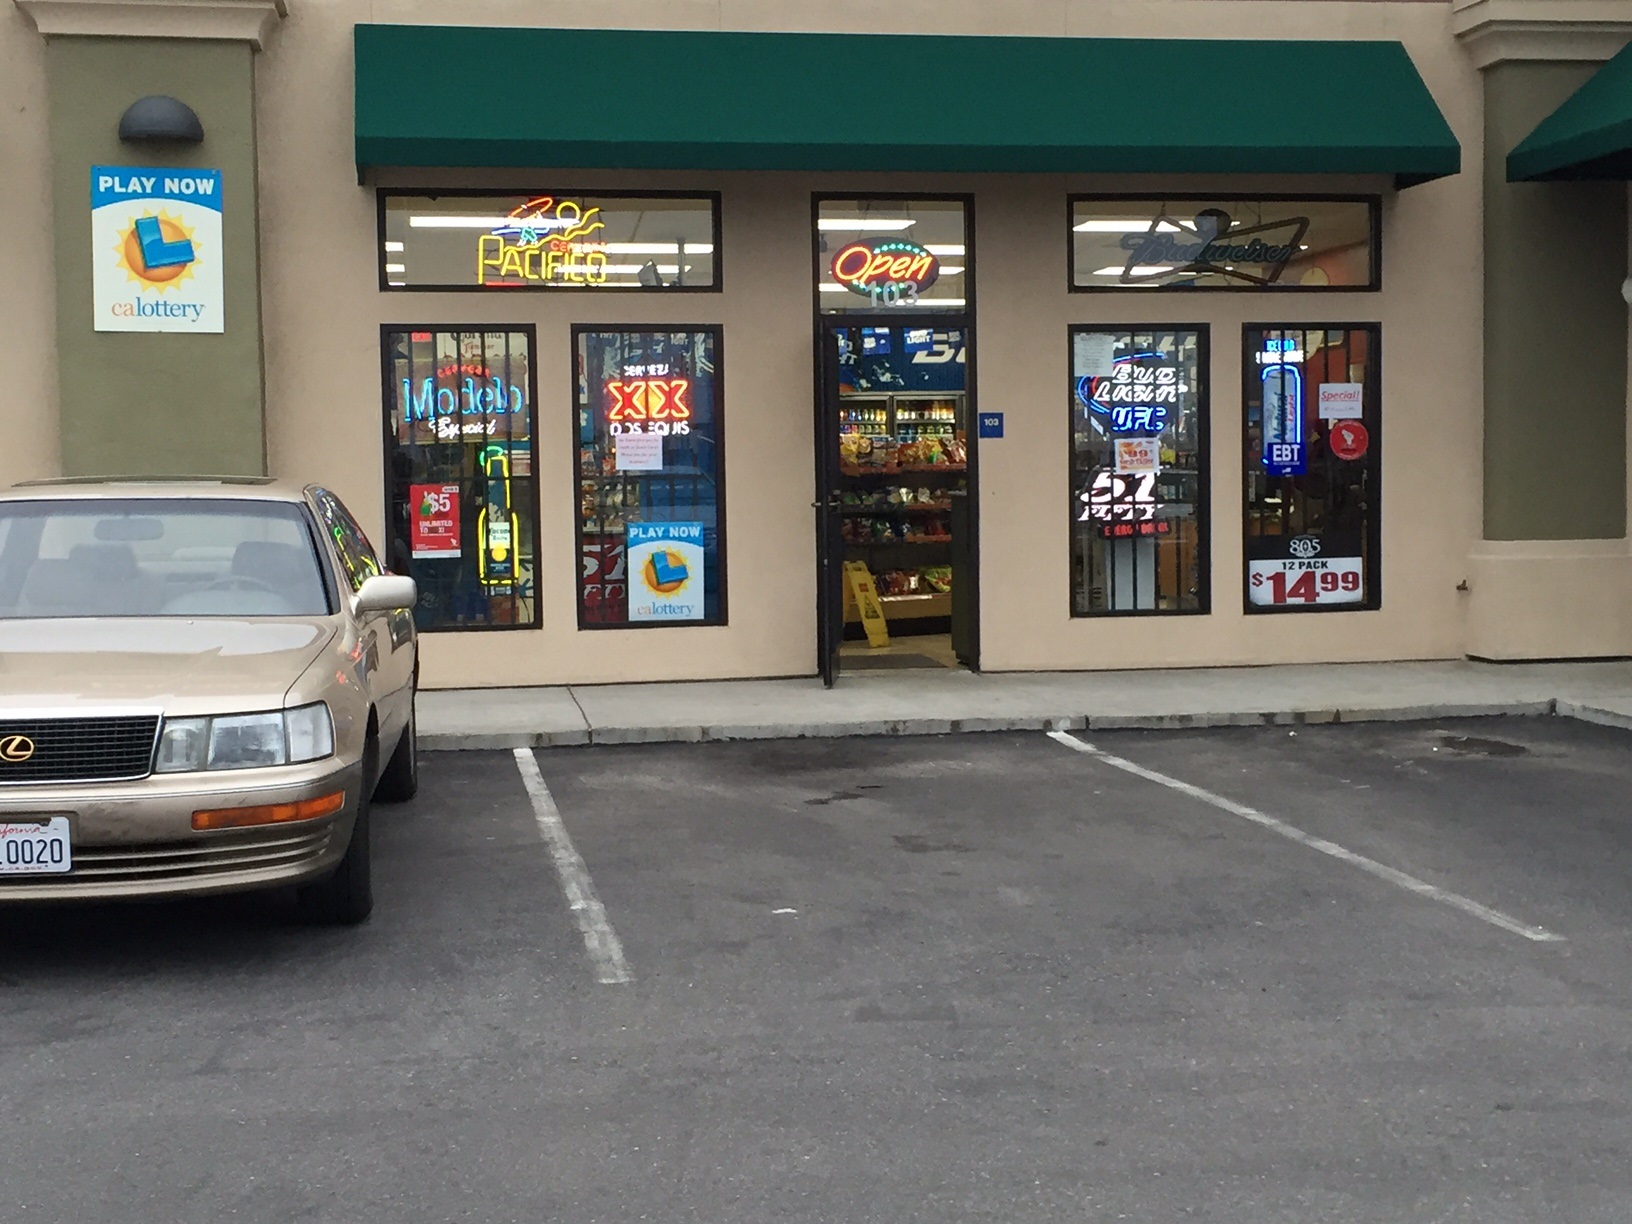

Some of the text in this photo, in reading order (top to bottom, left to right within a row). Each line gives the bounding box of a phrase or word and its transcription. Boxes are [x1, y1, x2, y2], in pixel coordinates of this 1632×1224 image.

[98, 175, 215, 195] PLAY NOW
[1119, 232, 1298, 264] Budweiser
[478, 234, 607, 284] PACIFICO
[835, 246, 933, 285] Open
[865, 280, 919, 308] 103
[111, 297, 205, 323] calottery
[402, 376, 523, 422] Modelo
[609, 420, 690, 437] DOS EQUIS
[984, 418, 999, 426] 103
[1272, 443, 1301, 462] EBT
[428, 492, 451, 514] $5
[629, 527, 700, 538] PLAY NOW
[1289, 539, 1321, 555] 805
[1281, 561, 1329, 571] 12 PACK
[638, 602, 695, 617] calottery
[0, 838, 63, 865] 0020
